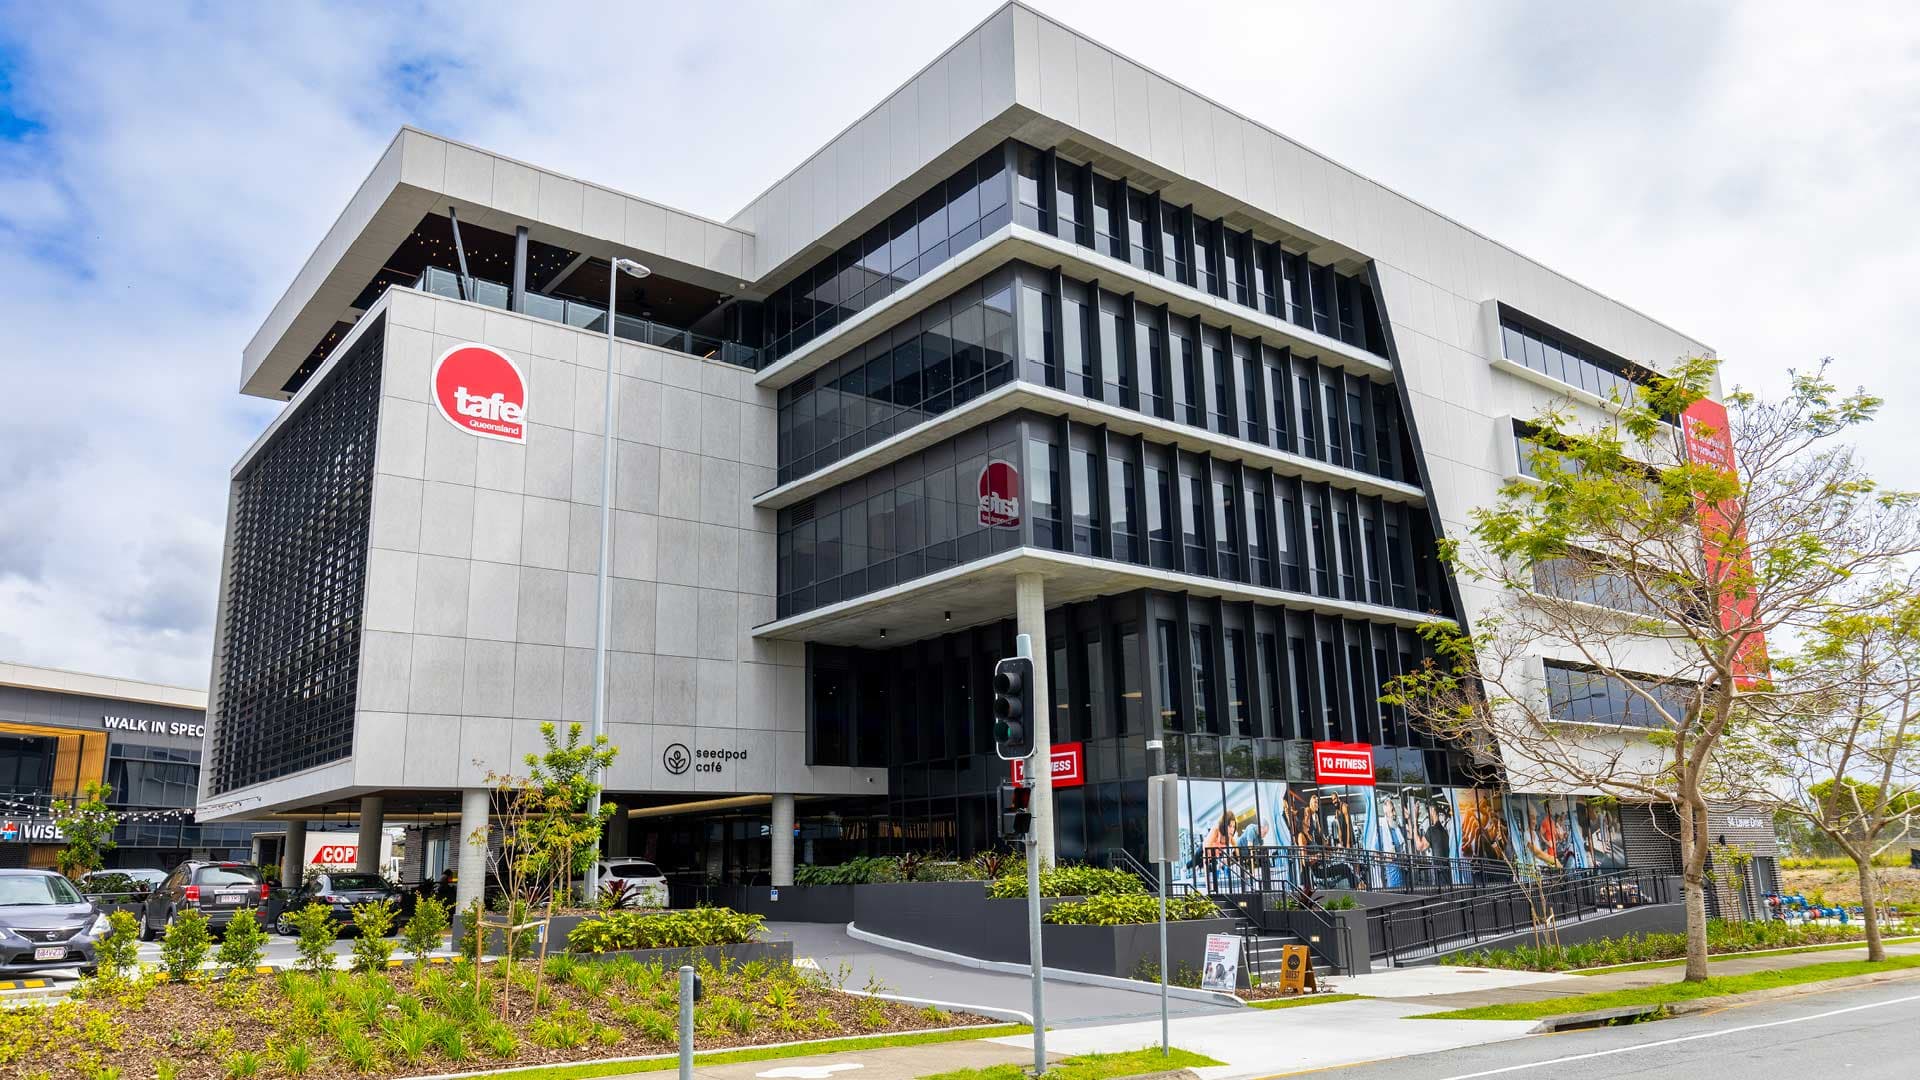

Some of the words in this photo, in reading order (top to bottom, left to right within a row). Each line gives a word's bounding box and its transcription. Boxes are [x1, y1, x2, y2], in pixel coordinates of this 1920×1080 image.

[453, 386, 523, 425] tafe
[469, 419, 519, 435] Queensland
[104, 715, 148, 731] WALK
[151, 721, 166, 733] IN
[696, 748, 747, 762] seedpod
[696, 761, 722, 773] café
[1322, 757, 1333, 769] TQ
[1335, 758, 1367, 770] FITNESS
